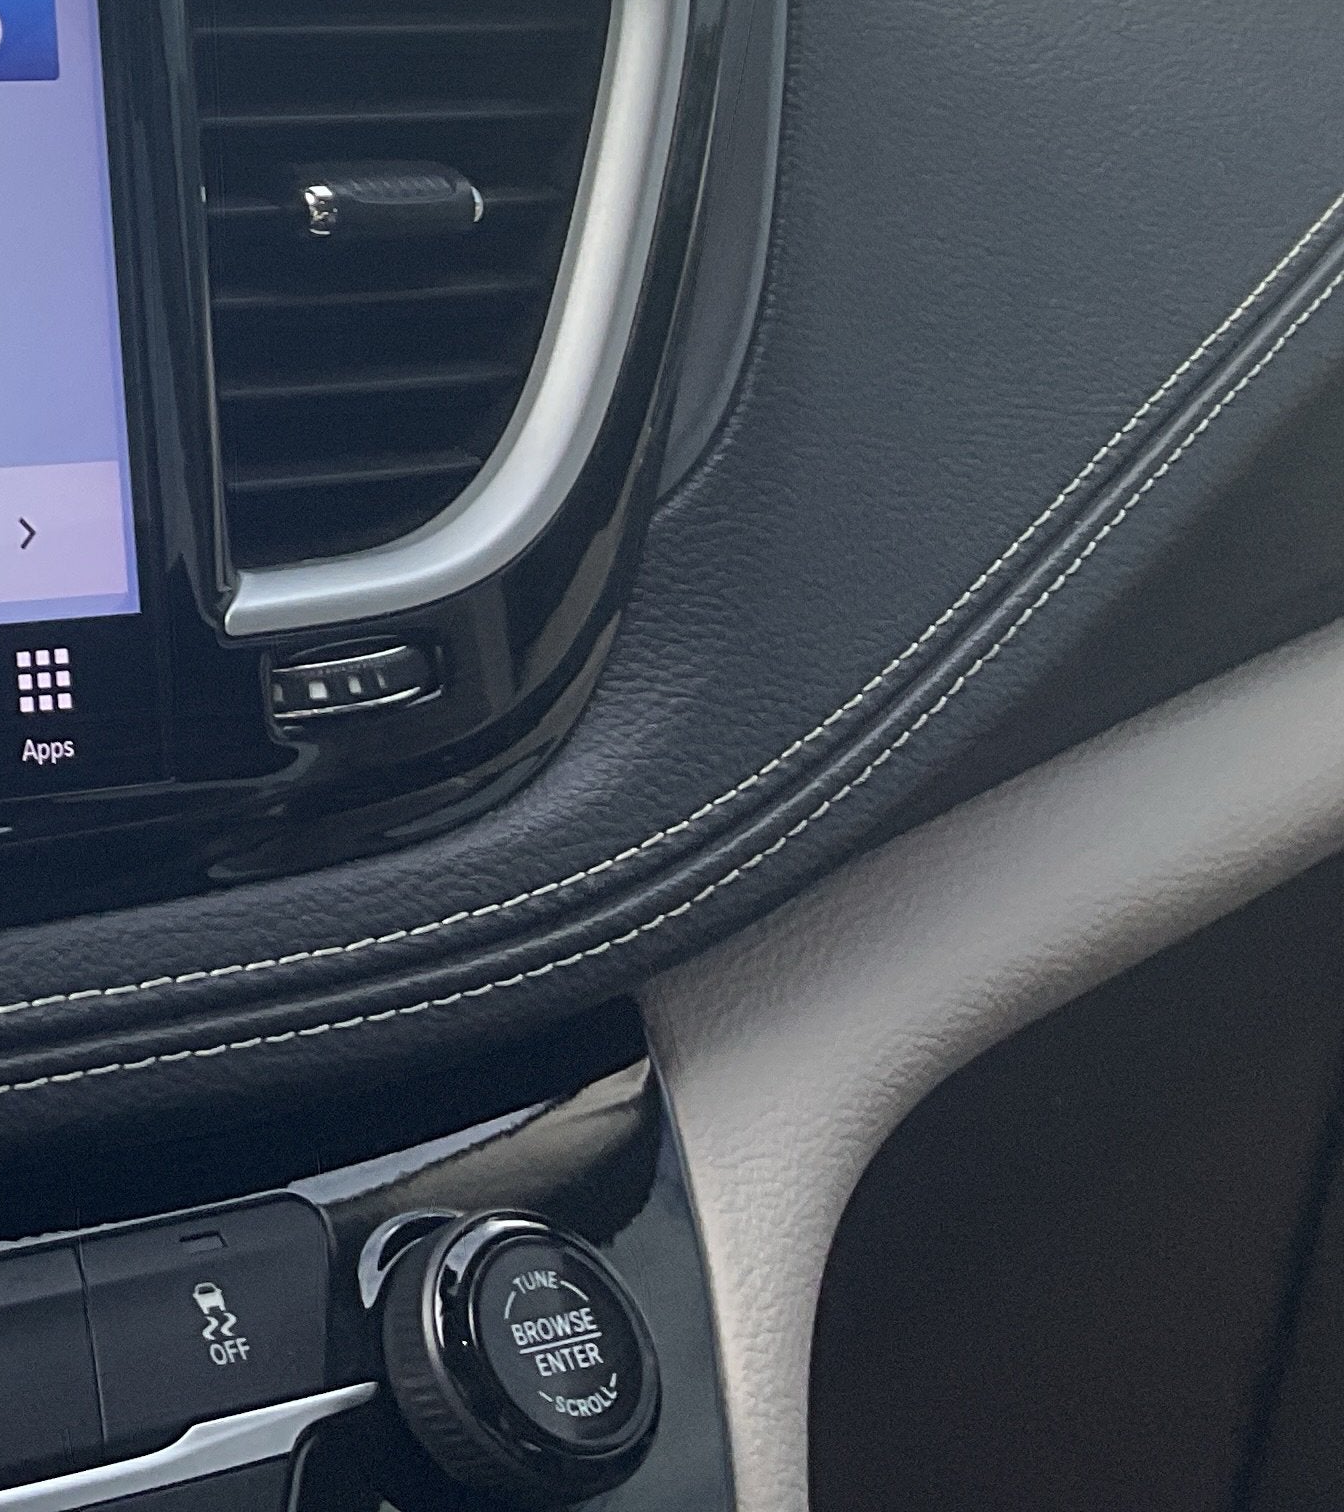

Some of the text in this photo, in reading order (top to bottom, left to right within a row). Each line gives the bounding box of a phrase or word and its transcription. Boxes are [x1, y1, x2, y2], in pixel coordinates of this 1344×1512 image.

[22, 737, 75, 766] Apps
[513, 1270, 559, 1294] TUNE
[512, 1306, 599, 1347] BROWSE
[210, 1336, 251, 1366] OFF
[534, 1343, 605, 1377] ENTER
[553, 1383, 618, 1419] SCROLL
